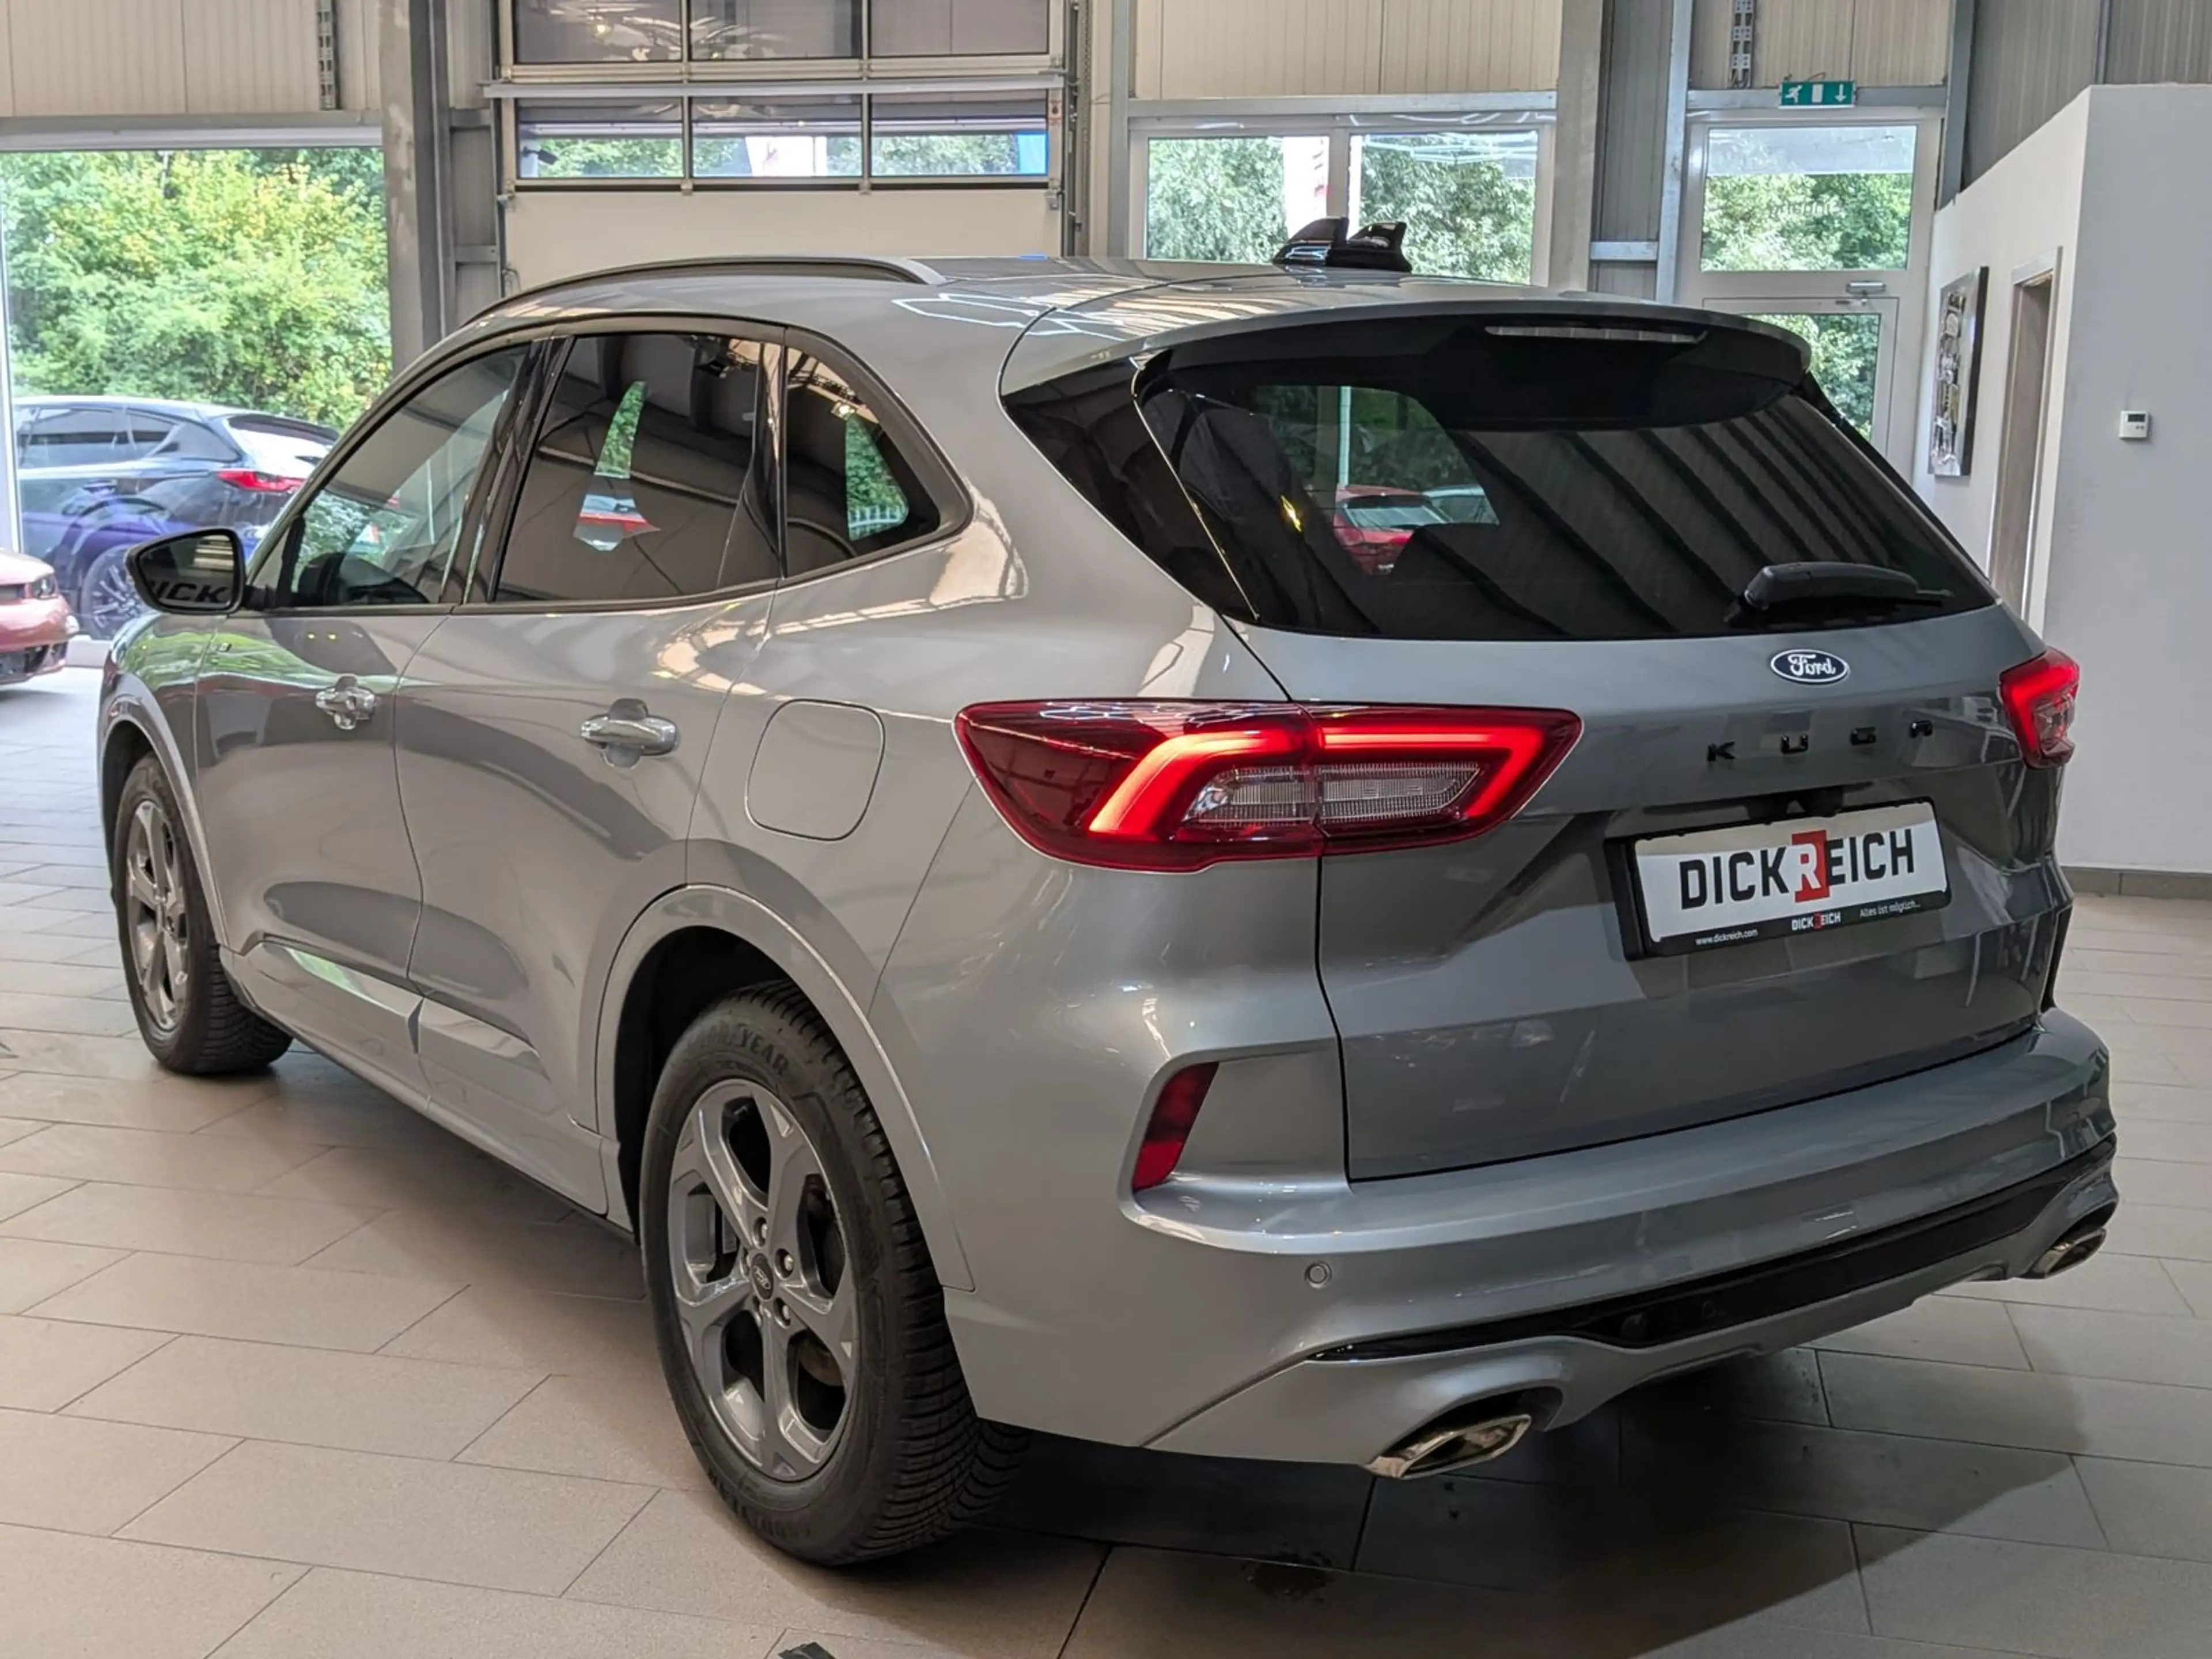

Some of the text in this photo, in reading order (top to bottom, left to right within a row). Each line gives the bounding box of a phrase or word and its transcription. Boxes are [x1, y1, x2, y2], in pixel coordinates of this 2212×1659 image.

[1787, 654, 1836, 676] Ford
[1679, 828, 1914, 910] DICKREICH
[1695, 929, 1758, 945] www.dickreich.com
